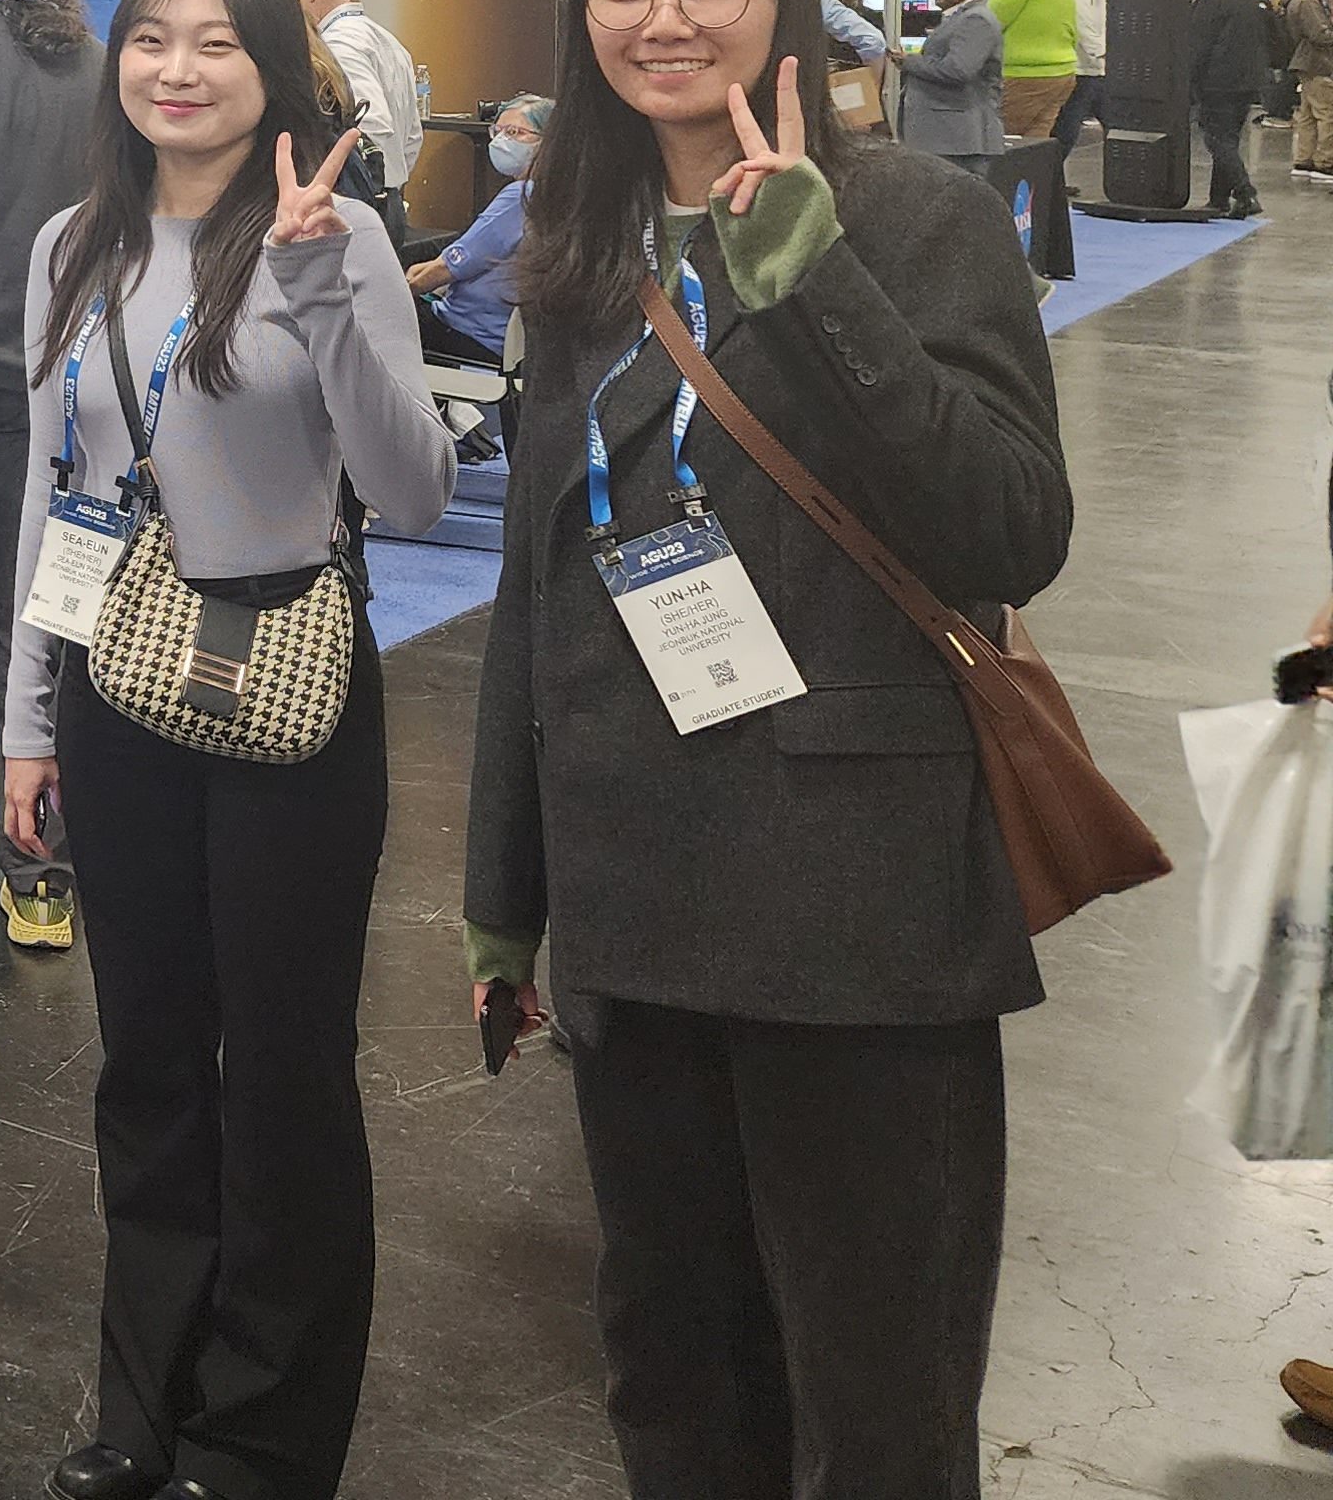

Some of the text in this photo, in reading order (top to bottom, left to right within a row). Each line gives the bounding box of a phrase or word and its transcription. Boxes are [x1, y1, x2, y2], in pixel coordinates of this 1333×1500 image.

[155, 332, 177, 373] AGU23
[65, 377, 76, 420] AGU23
[143, 389, 161, 444] BATTELL
[75, 503, 107, 521] AGU23
[61, 531, 109, 555] SEA-EUN
[639, 541, 686, 567] AGU23
[78, 570, 105, 586] NATIONA
[649, 579, 713, 610] YUN-HA
[660, 597, 721, 627] (SHE/HER)
[662, 608, 729, 638] YUN-HA JUNG
[658, 616, 745, 653] JEONBUK NATIONAL
[679, 632, 733, 656] UNIVERSITY
[692, 686, 787, 725] GRADUATE STUDENT
